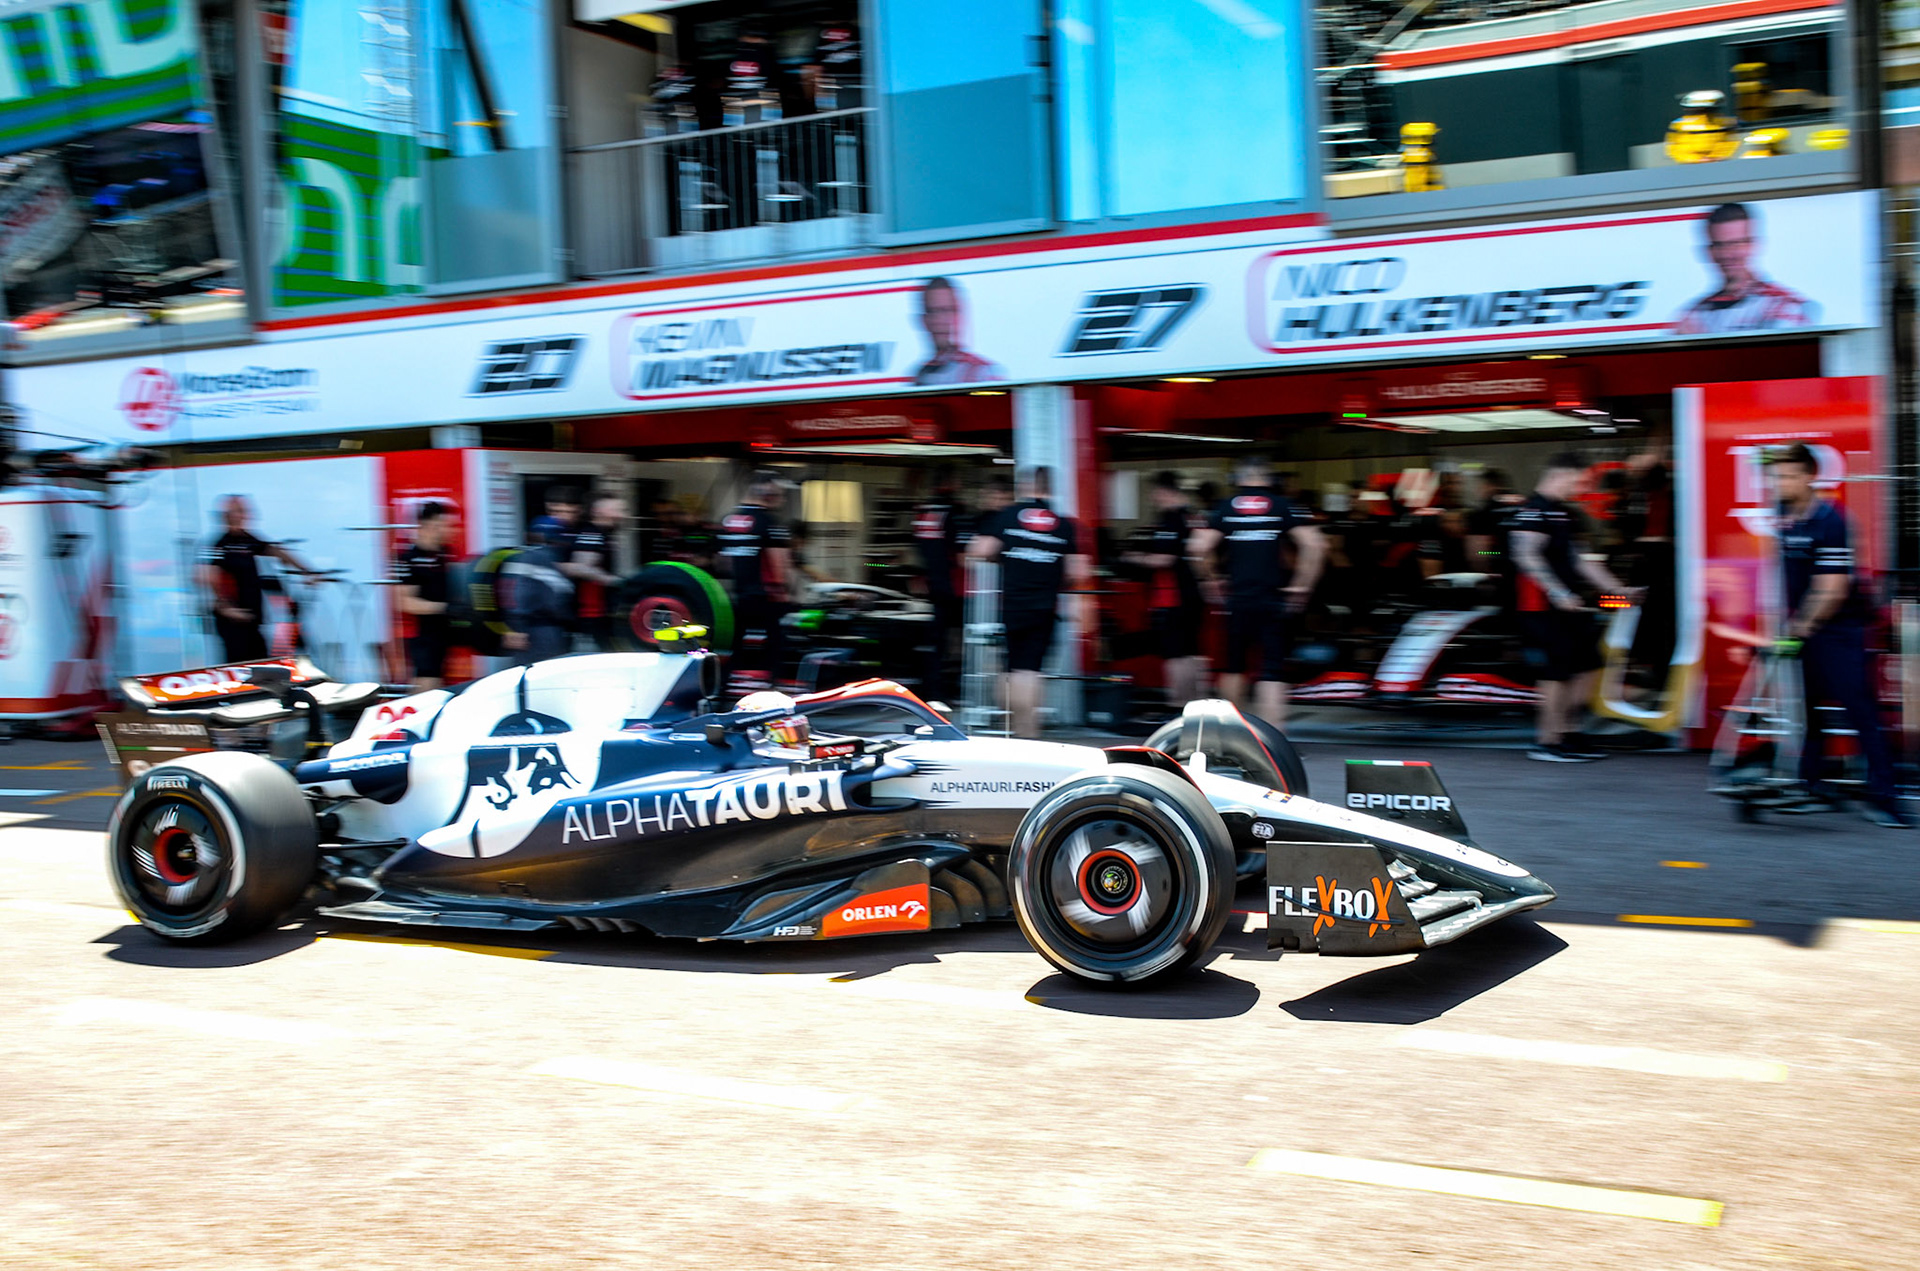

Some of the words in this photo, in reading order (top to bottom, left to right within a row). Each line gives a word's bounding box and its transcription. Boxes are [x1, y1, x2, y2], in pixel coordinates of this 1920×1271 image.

[147, 775, 190, 791] PIRELLI
[930, 781, 1056, 793] ALPHATAURI.FASH
[562, 769, 848, 844] ALPHATAURI
[1252, 823, 1274, 838] FIA
[841, 905, 898, 922] ORLEN
